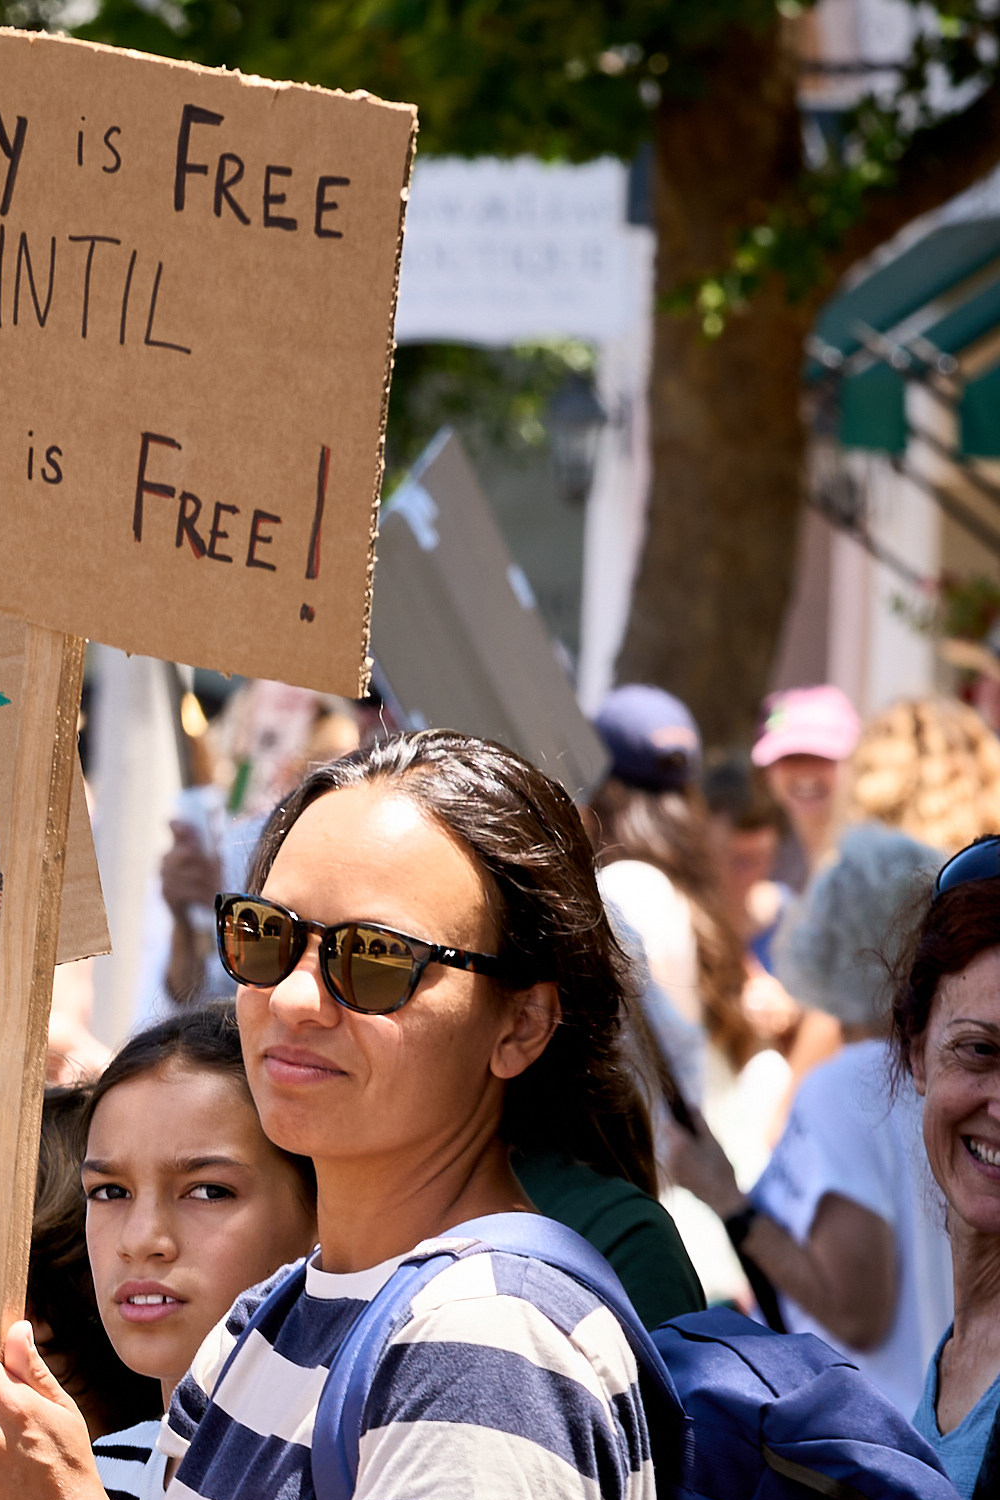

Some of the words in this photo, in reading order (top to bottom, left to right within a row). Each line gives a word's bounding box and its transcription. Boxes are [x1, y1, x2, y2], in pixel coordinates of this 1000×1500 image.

[76, 116, 122, 173] is
[173, 104, 351, 238] FREE
[27, 431, 63, 485] is
[133, 431, 331, 622] FREE!
